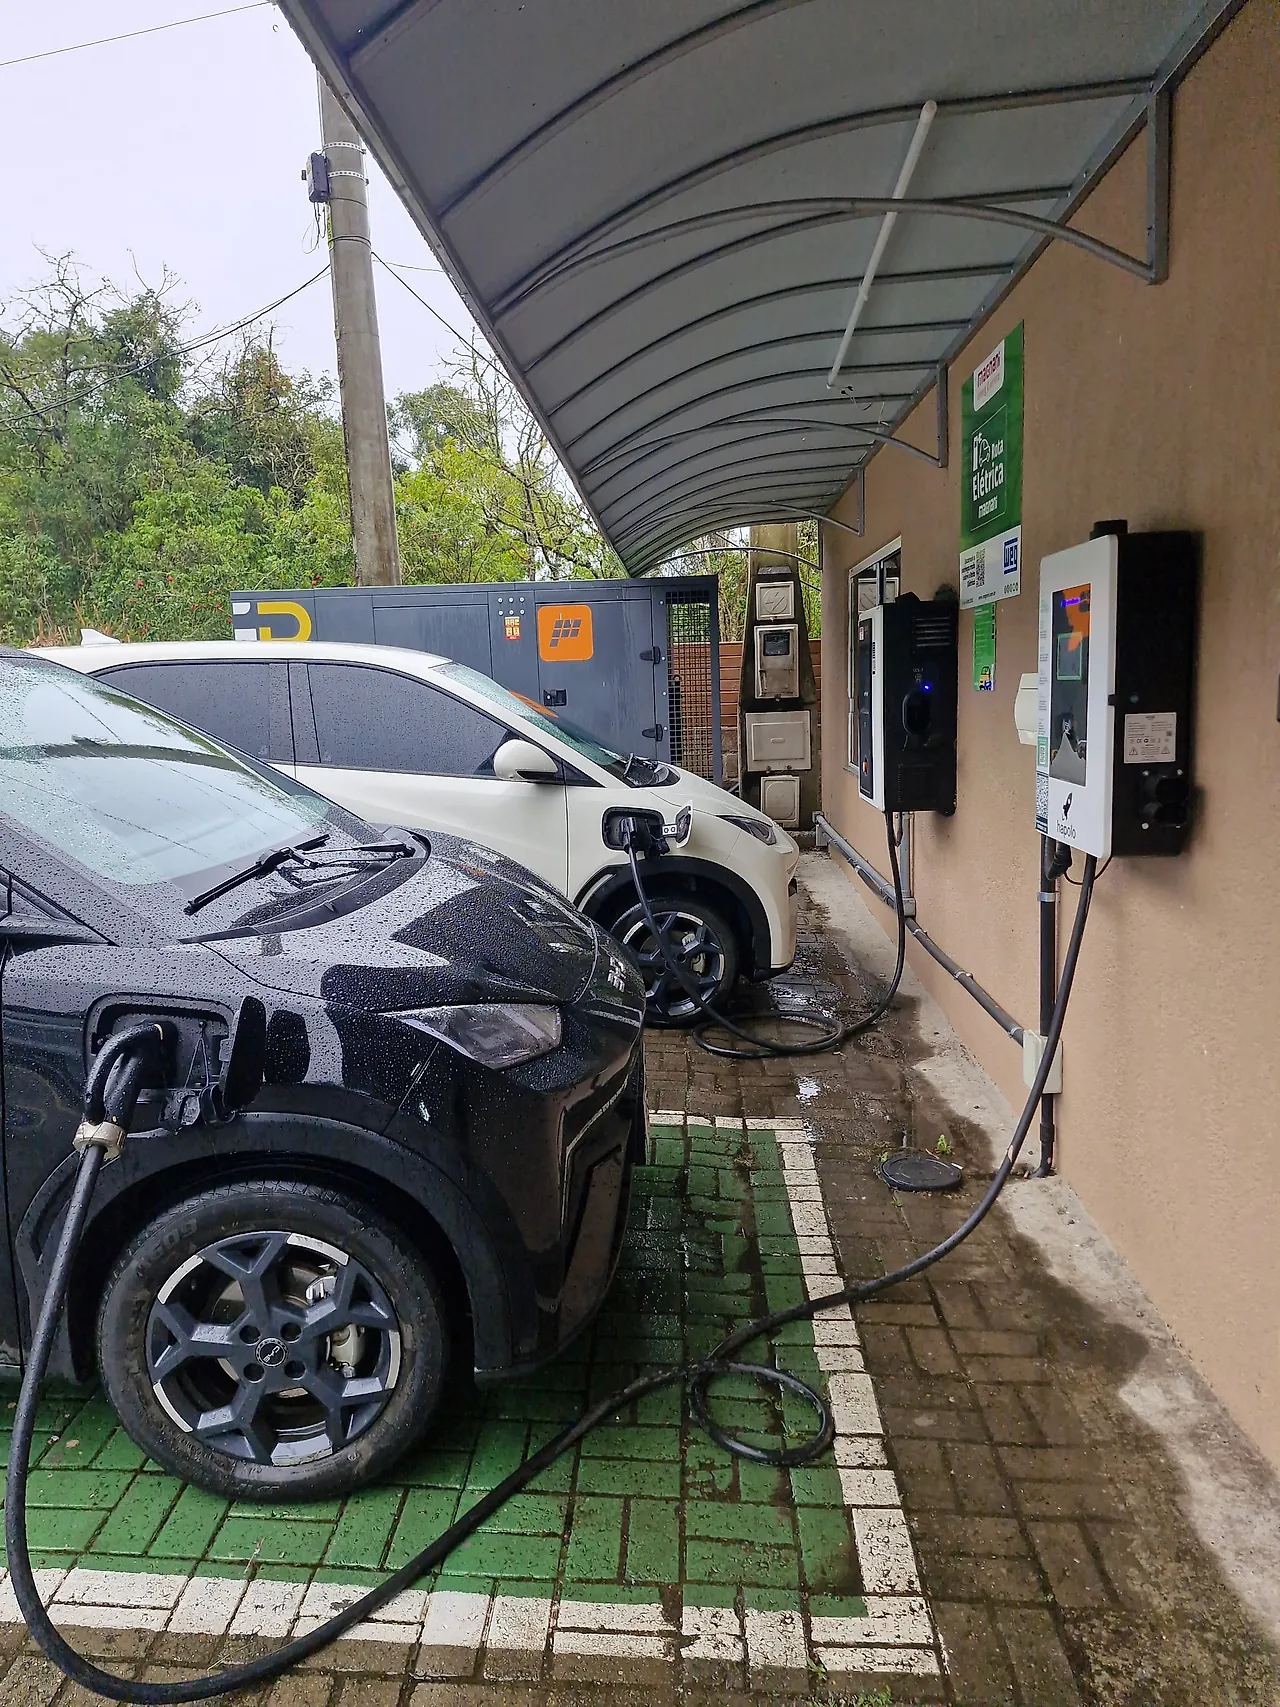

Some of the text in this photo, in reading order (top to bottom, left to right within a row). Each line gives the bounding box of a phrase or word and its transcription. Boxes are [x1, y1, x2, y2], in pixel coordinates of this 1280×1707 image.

[991, 439, 1004, 460] Rota
[972, 461, 1004, 502] Elétrica
[262, 1345, 281, 1363] BYD
